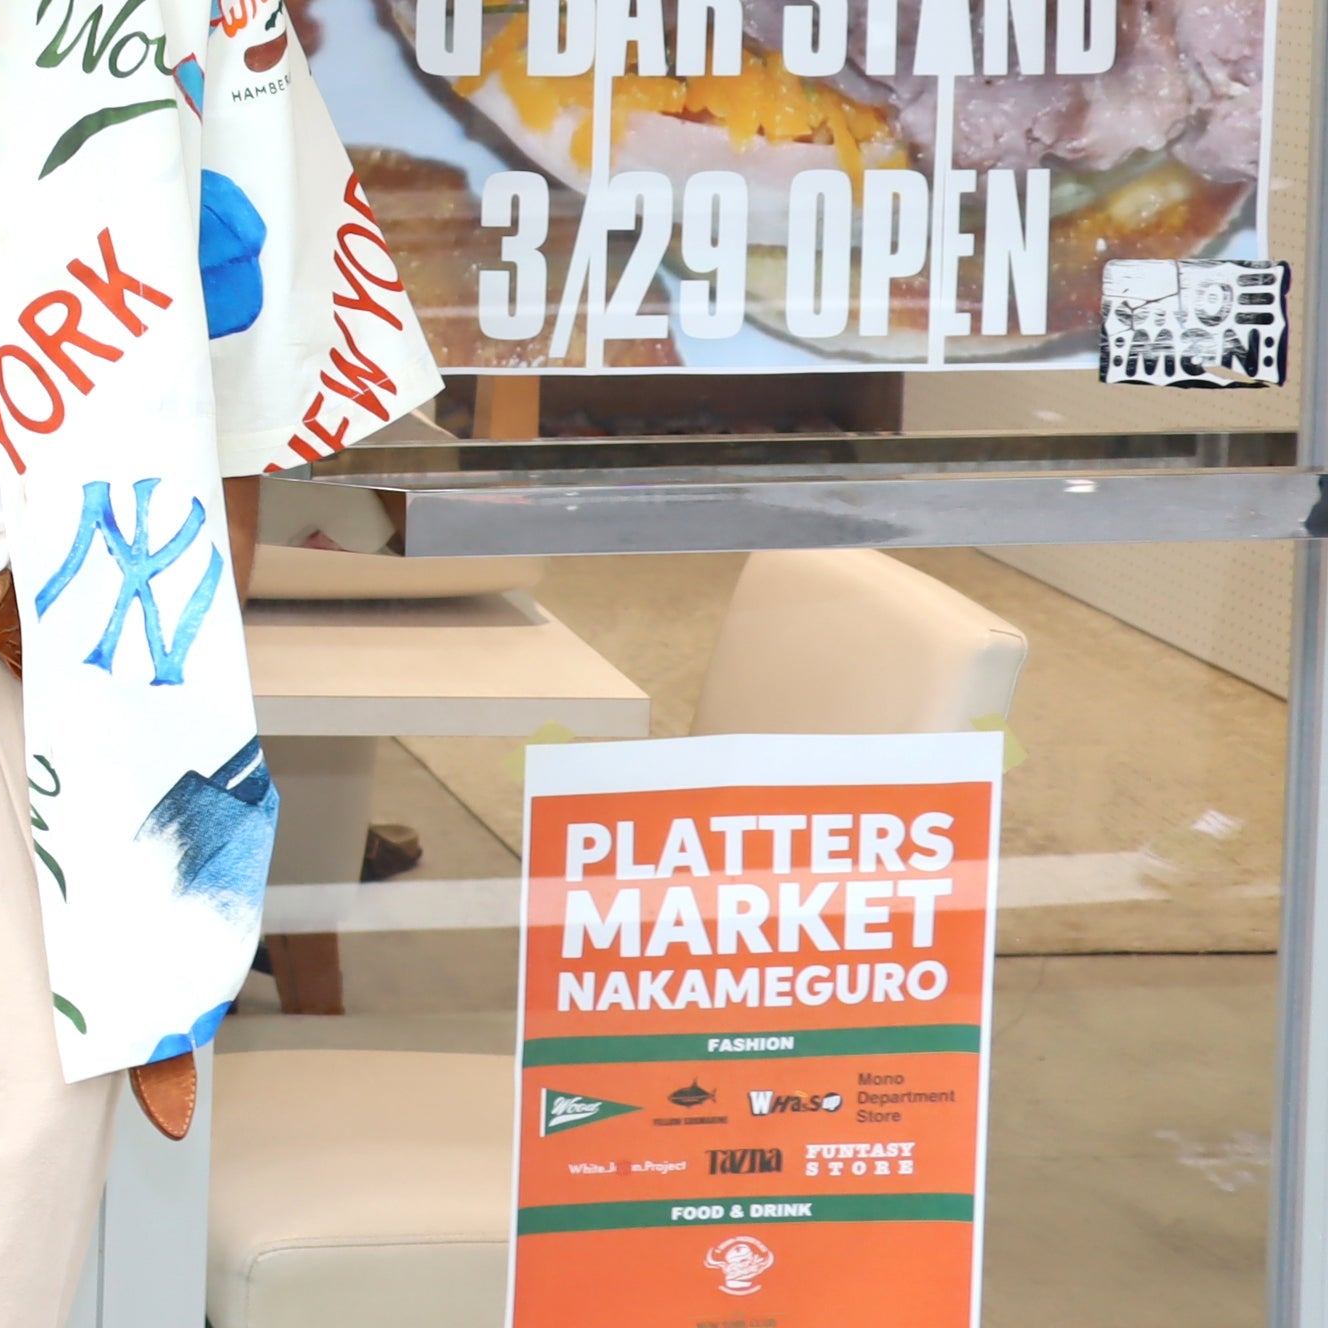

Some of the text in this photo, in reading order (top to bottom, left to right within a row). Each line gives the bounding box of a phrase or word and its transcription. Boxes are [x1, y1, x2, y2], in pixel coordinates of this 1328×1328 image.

[479, 166, 1051, 360] 3/29 OPEN
[565, 812, 955, 882] PLATTERS
[561, 878, 953, 959] MARKET
[557, 960, 949, 1012] NAKAMEGURO
[707, 1036, 795, 1053] FASHION
[858, 1073, 904, 1085] Mono
[857, 1090, 955, 1105] Department
[856, 1109, 901, 1123] Store
[805, 1142, 915, 1159] FUNTASY
[805, 1160, 914, 1176] STORE
[671, 1203, 812, 1220] FOOD & DRINK
